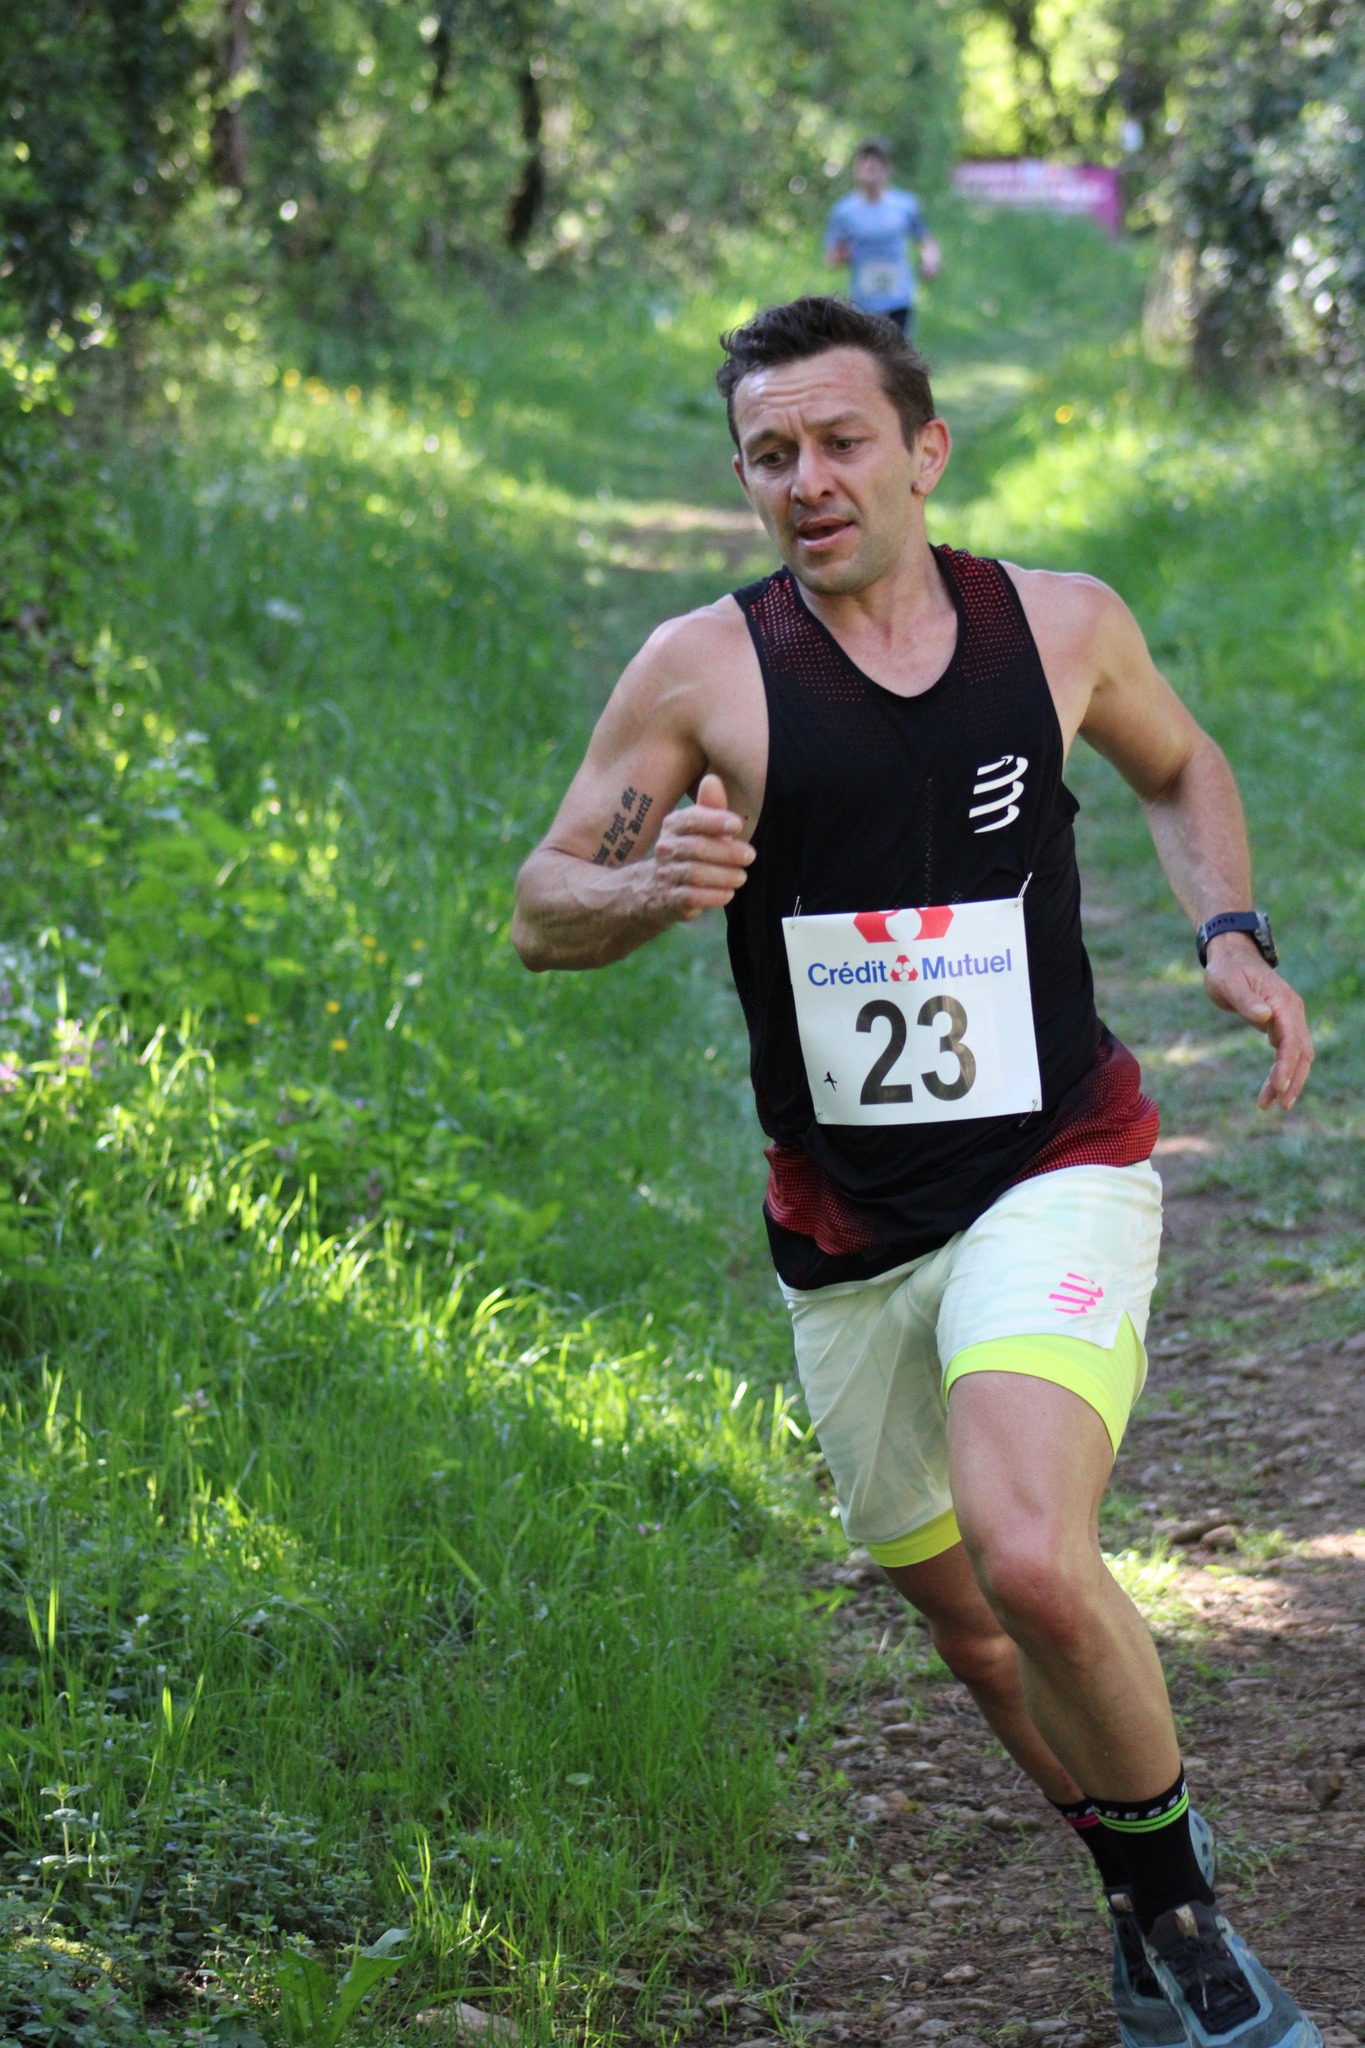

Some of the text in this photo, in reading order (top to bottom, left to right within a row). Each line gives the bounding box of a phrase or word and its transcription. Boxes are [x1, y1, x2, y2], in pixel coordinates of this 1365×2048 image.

[808, 949, 1012, 986] Crédit Mutuel
[855, 995, 977, 1106] 23
